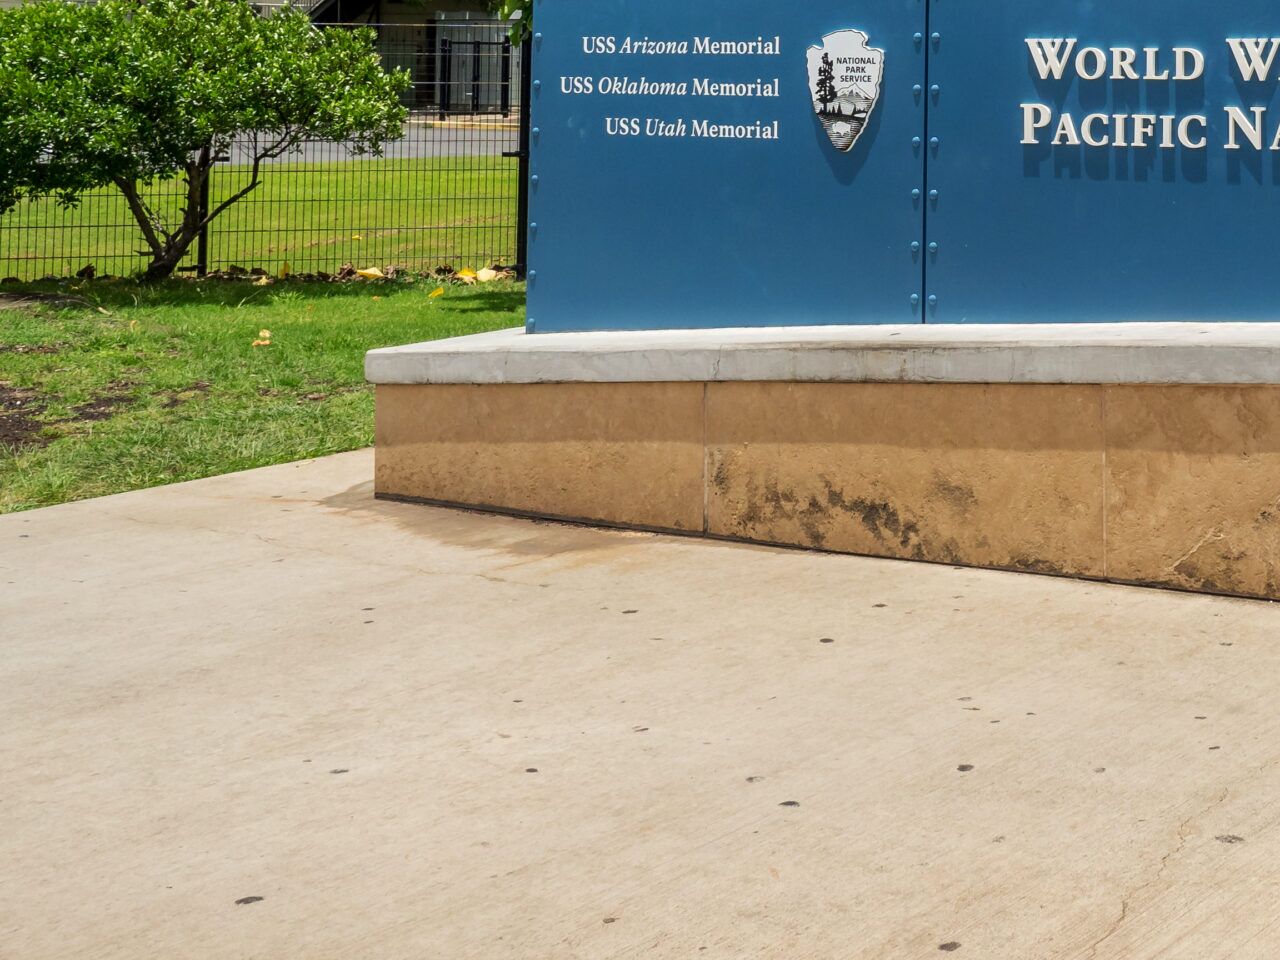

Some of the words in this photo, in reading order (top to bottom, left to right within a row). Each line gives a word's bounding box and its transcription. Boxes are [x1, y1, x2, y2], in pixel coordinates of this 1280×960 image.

[582, 36, 616, 54] USS
[619, 36, 688, 55] Arizona
[692, 36, 780, 55] Memorial
[836, 57, 877, 65] NATIONAL
[1025, 37, 1205, 81] WORLD
[839, 74, 872, 83] SERVICE
[845, 66, 867, 74] PARK
[560, 76, 594, 94] USS
[598, 76, 687, 96] Oklahoma
[692, 78, 780, 97] Memorial
[605, 117, 640, 136] USS
[645, 118, 686, 137] Utah
[691, 119, 779, 139] Memorial
[1020, 102, 1207, 149] PACIFIC
